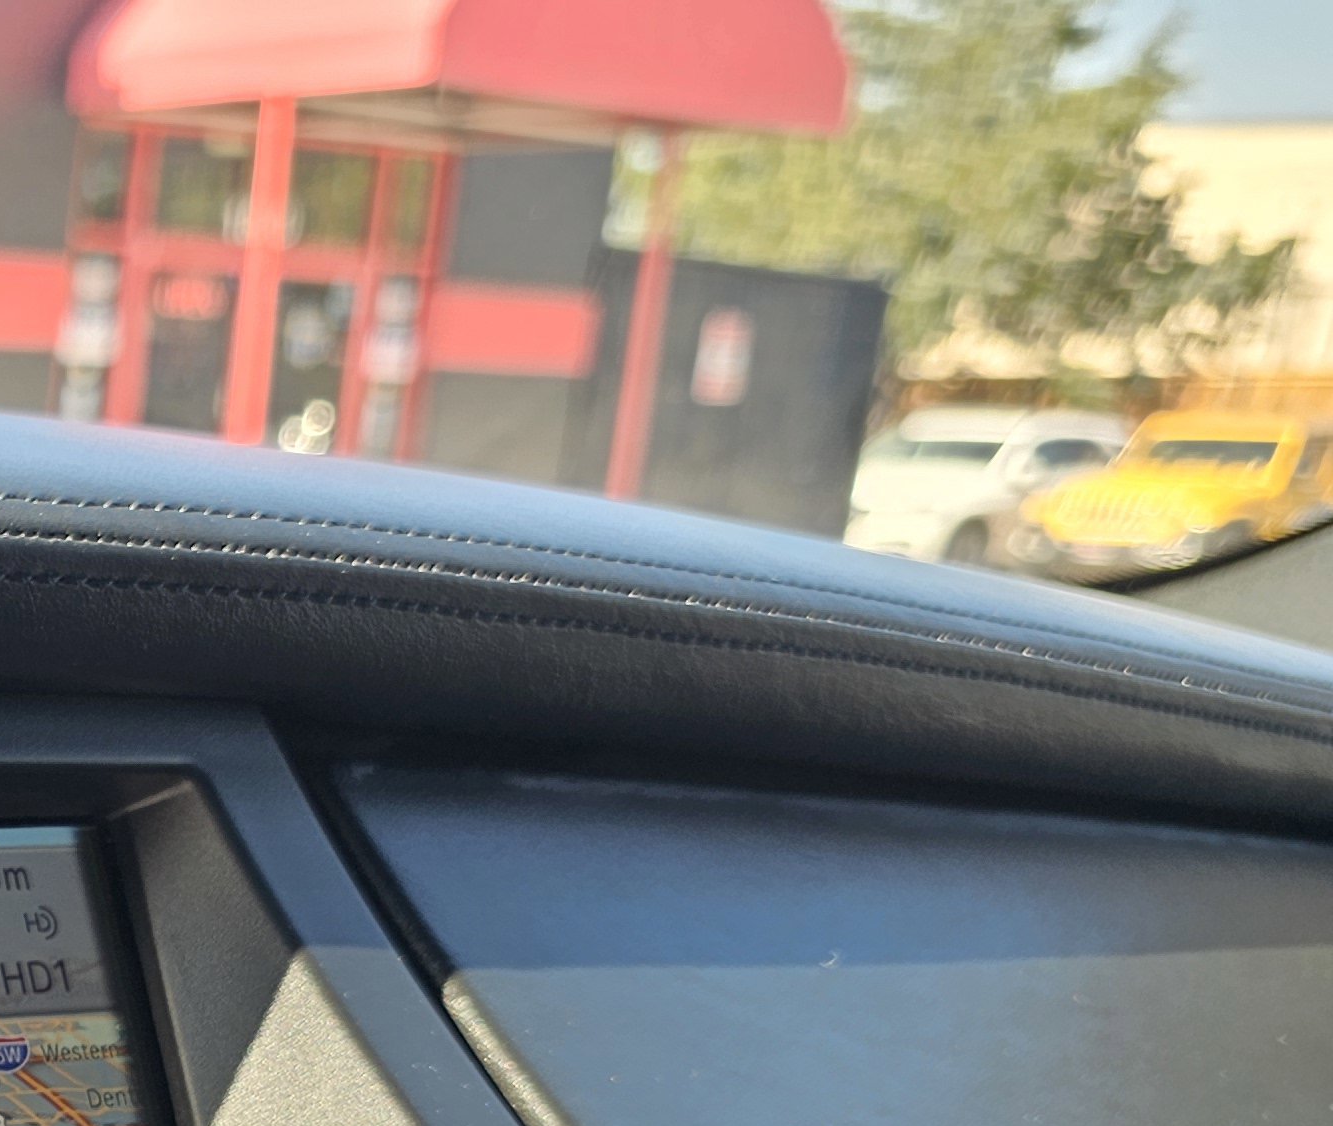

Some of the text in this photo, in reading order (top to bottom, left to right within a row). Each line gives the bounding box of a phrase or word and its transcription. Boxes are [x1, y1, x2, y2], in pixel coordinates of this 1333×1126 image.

[0, 959, 73, 995] HD1
[41, 1042, 120, 1064] Western
[86, 1086, 133, 1109] Den
